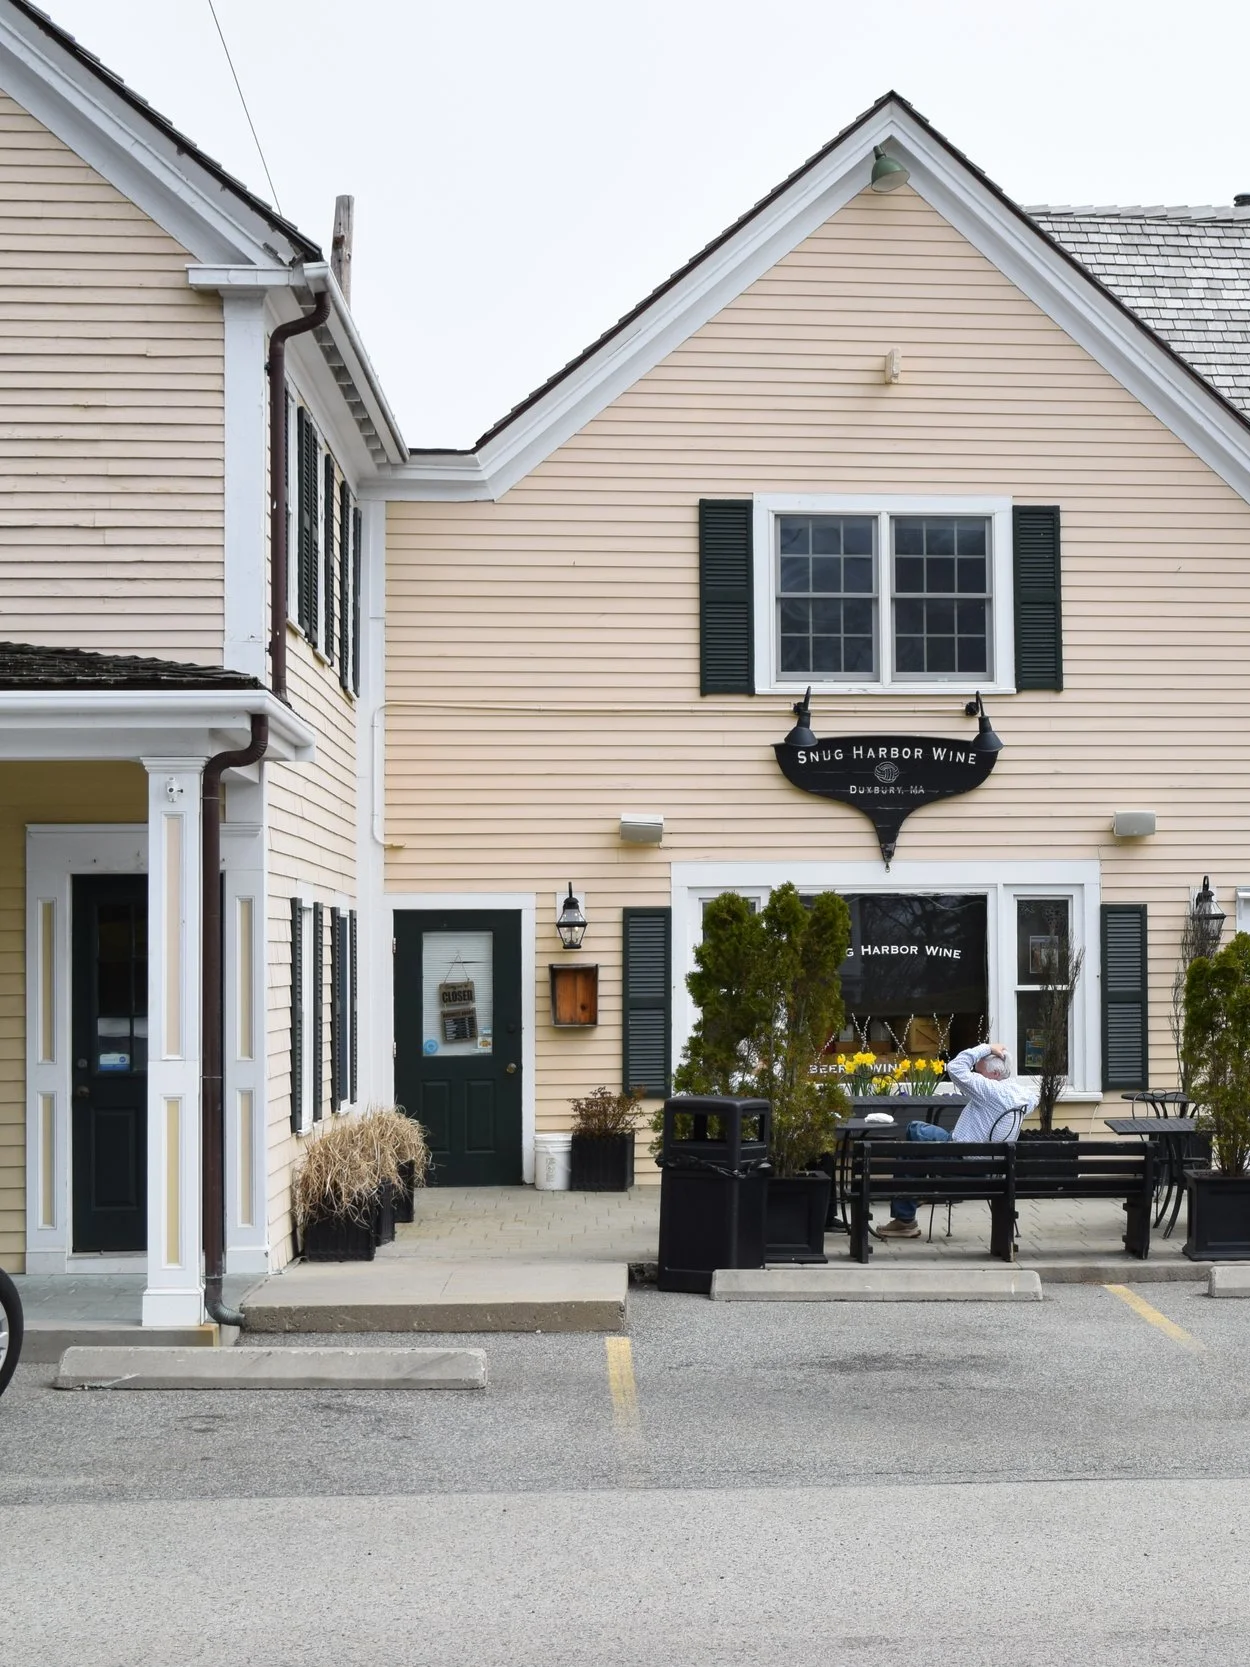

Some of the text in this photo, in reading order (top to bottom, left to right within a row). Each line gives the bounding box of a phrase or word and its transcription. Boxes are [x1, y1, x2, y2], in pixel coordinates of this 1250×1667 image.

[797, 746, 977, 765] SNUG HARBOR WINE
[861, 945, 918, 956] HARBOR
[925, 945, 962, 959] WINE
[443, 990, 473, 1002] CLOSED
